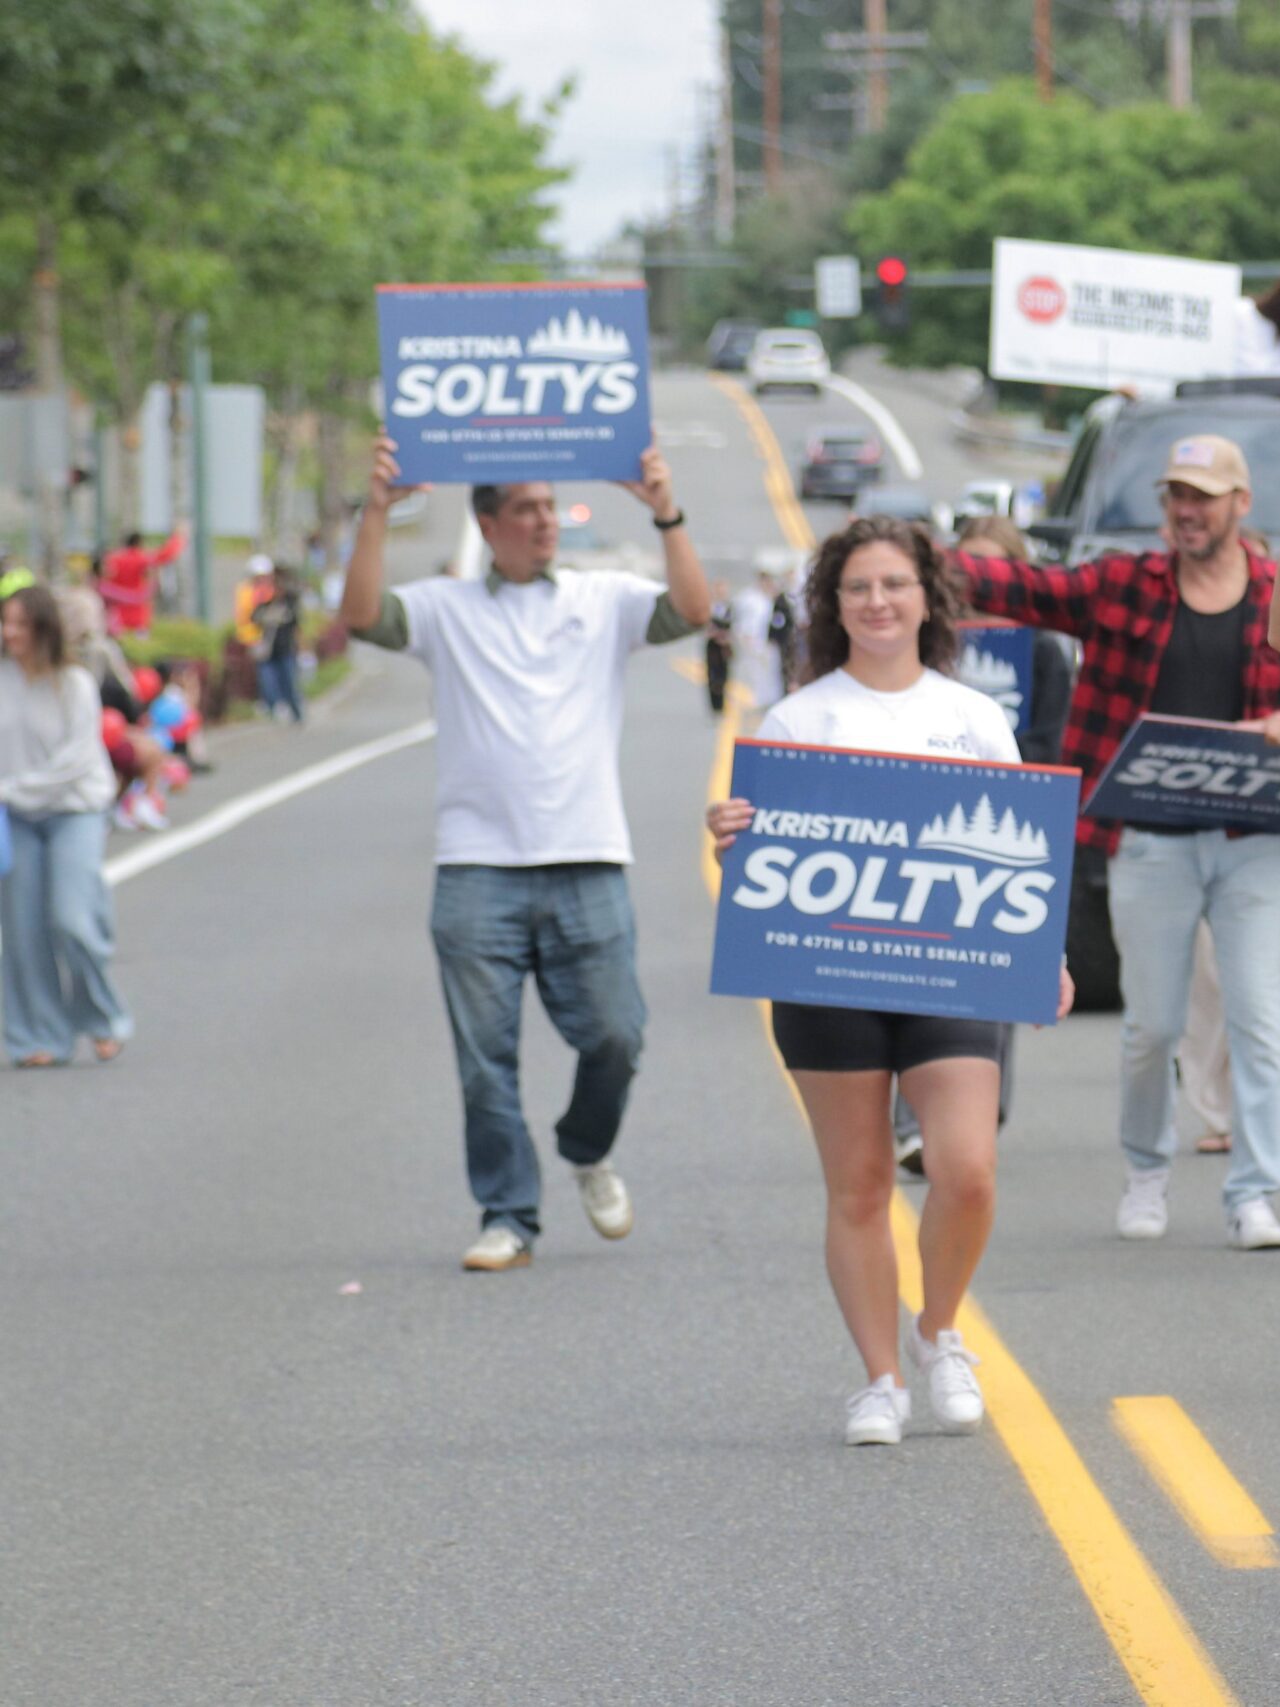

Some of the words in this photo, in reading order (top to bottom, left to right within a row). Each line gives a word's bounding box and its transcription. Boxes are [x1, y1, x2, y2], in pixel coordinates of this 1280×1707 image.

[398, 335, 525, 360] KRISTINA
[391, 361, 640, 418] SOLTYS
[760, 747, 808, 761] HOME
[819, 753, 838, 764] IS
[849, 756, 910, 770] WORTH
[920, 762, 1008, 780] FIGHTING
[1019, 772, 1053, 784] FOR
[752, 808, 909, 849] KRISTINA
[732, 845, 1057, 935] SOLTYS
[765, 931, 799, 947] FOR
[803, 934, 844, 951] 47TH
[848, 939, 869, 953] LD
[872, 942, 922, 959] STATE
[926, 946, 988, 966] SENATE
[989, 950, 1012, 968] (R)
[815, 965, 957, 989] KRISTINAFORSENATE.COM
